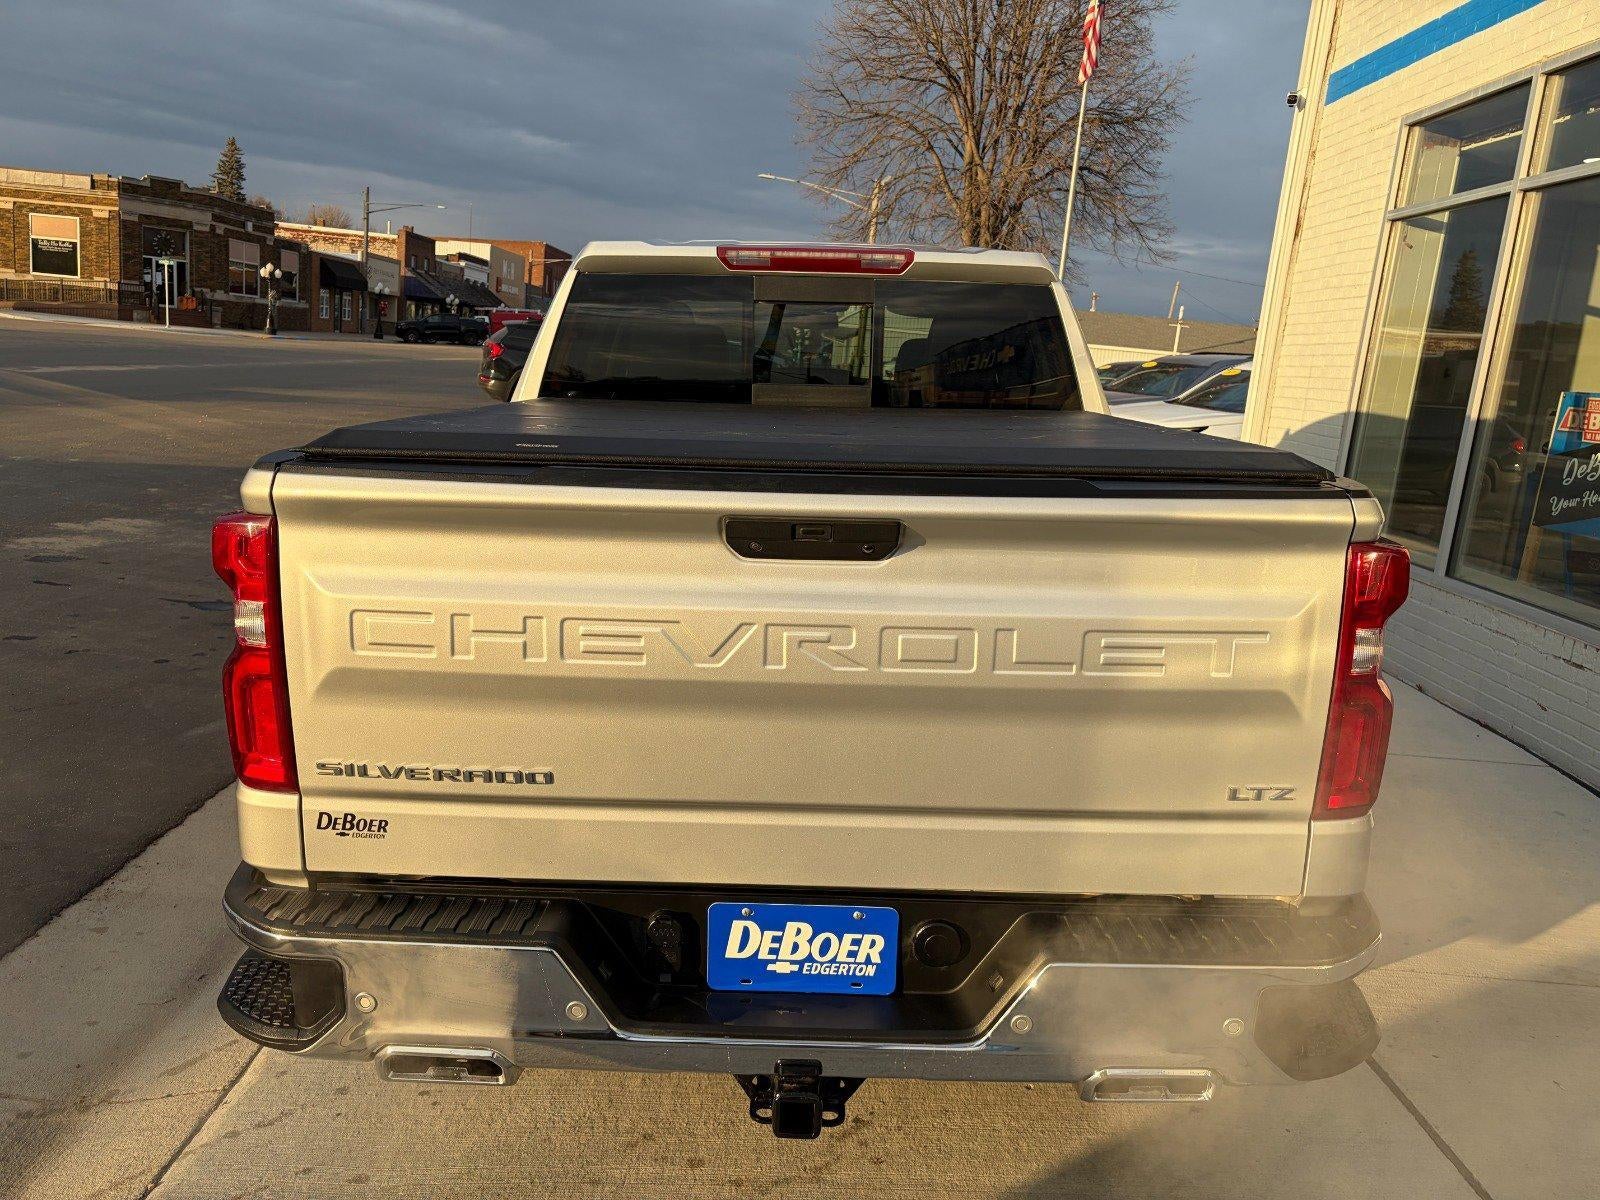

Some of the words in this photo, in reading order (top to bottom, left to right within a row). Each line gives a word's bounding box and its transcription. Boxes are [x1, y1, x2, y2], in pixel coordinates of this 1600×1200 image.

[1549, 495, 1581, 516] Your
[349, 608, 1271, 678] CHEVROLET
[316, 761, 555, 785] SILVERADO
[1226, 785, 1297, 802] LTZ
[351, 832, 386, 840] EDGERTON
[802, 962, 877, 977] EDGERTON
